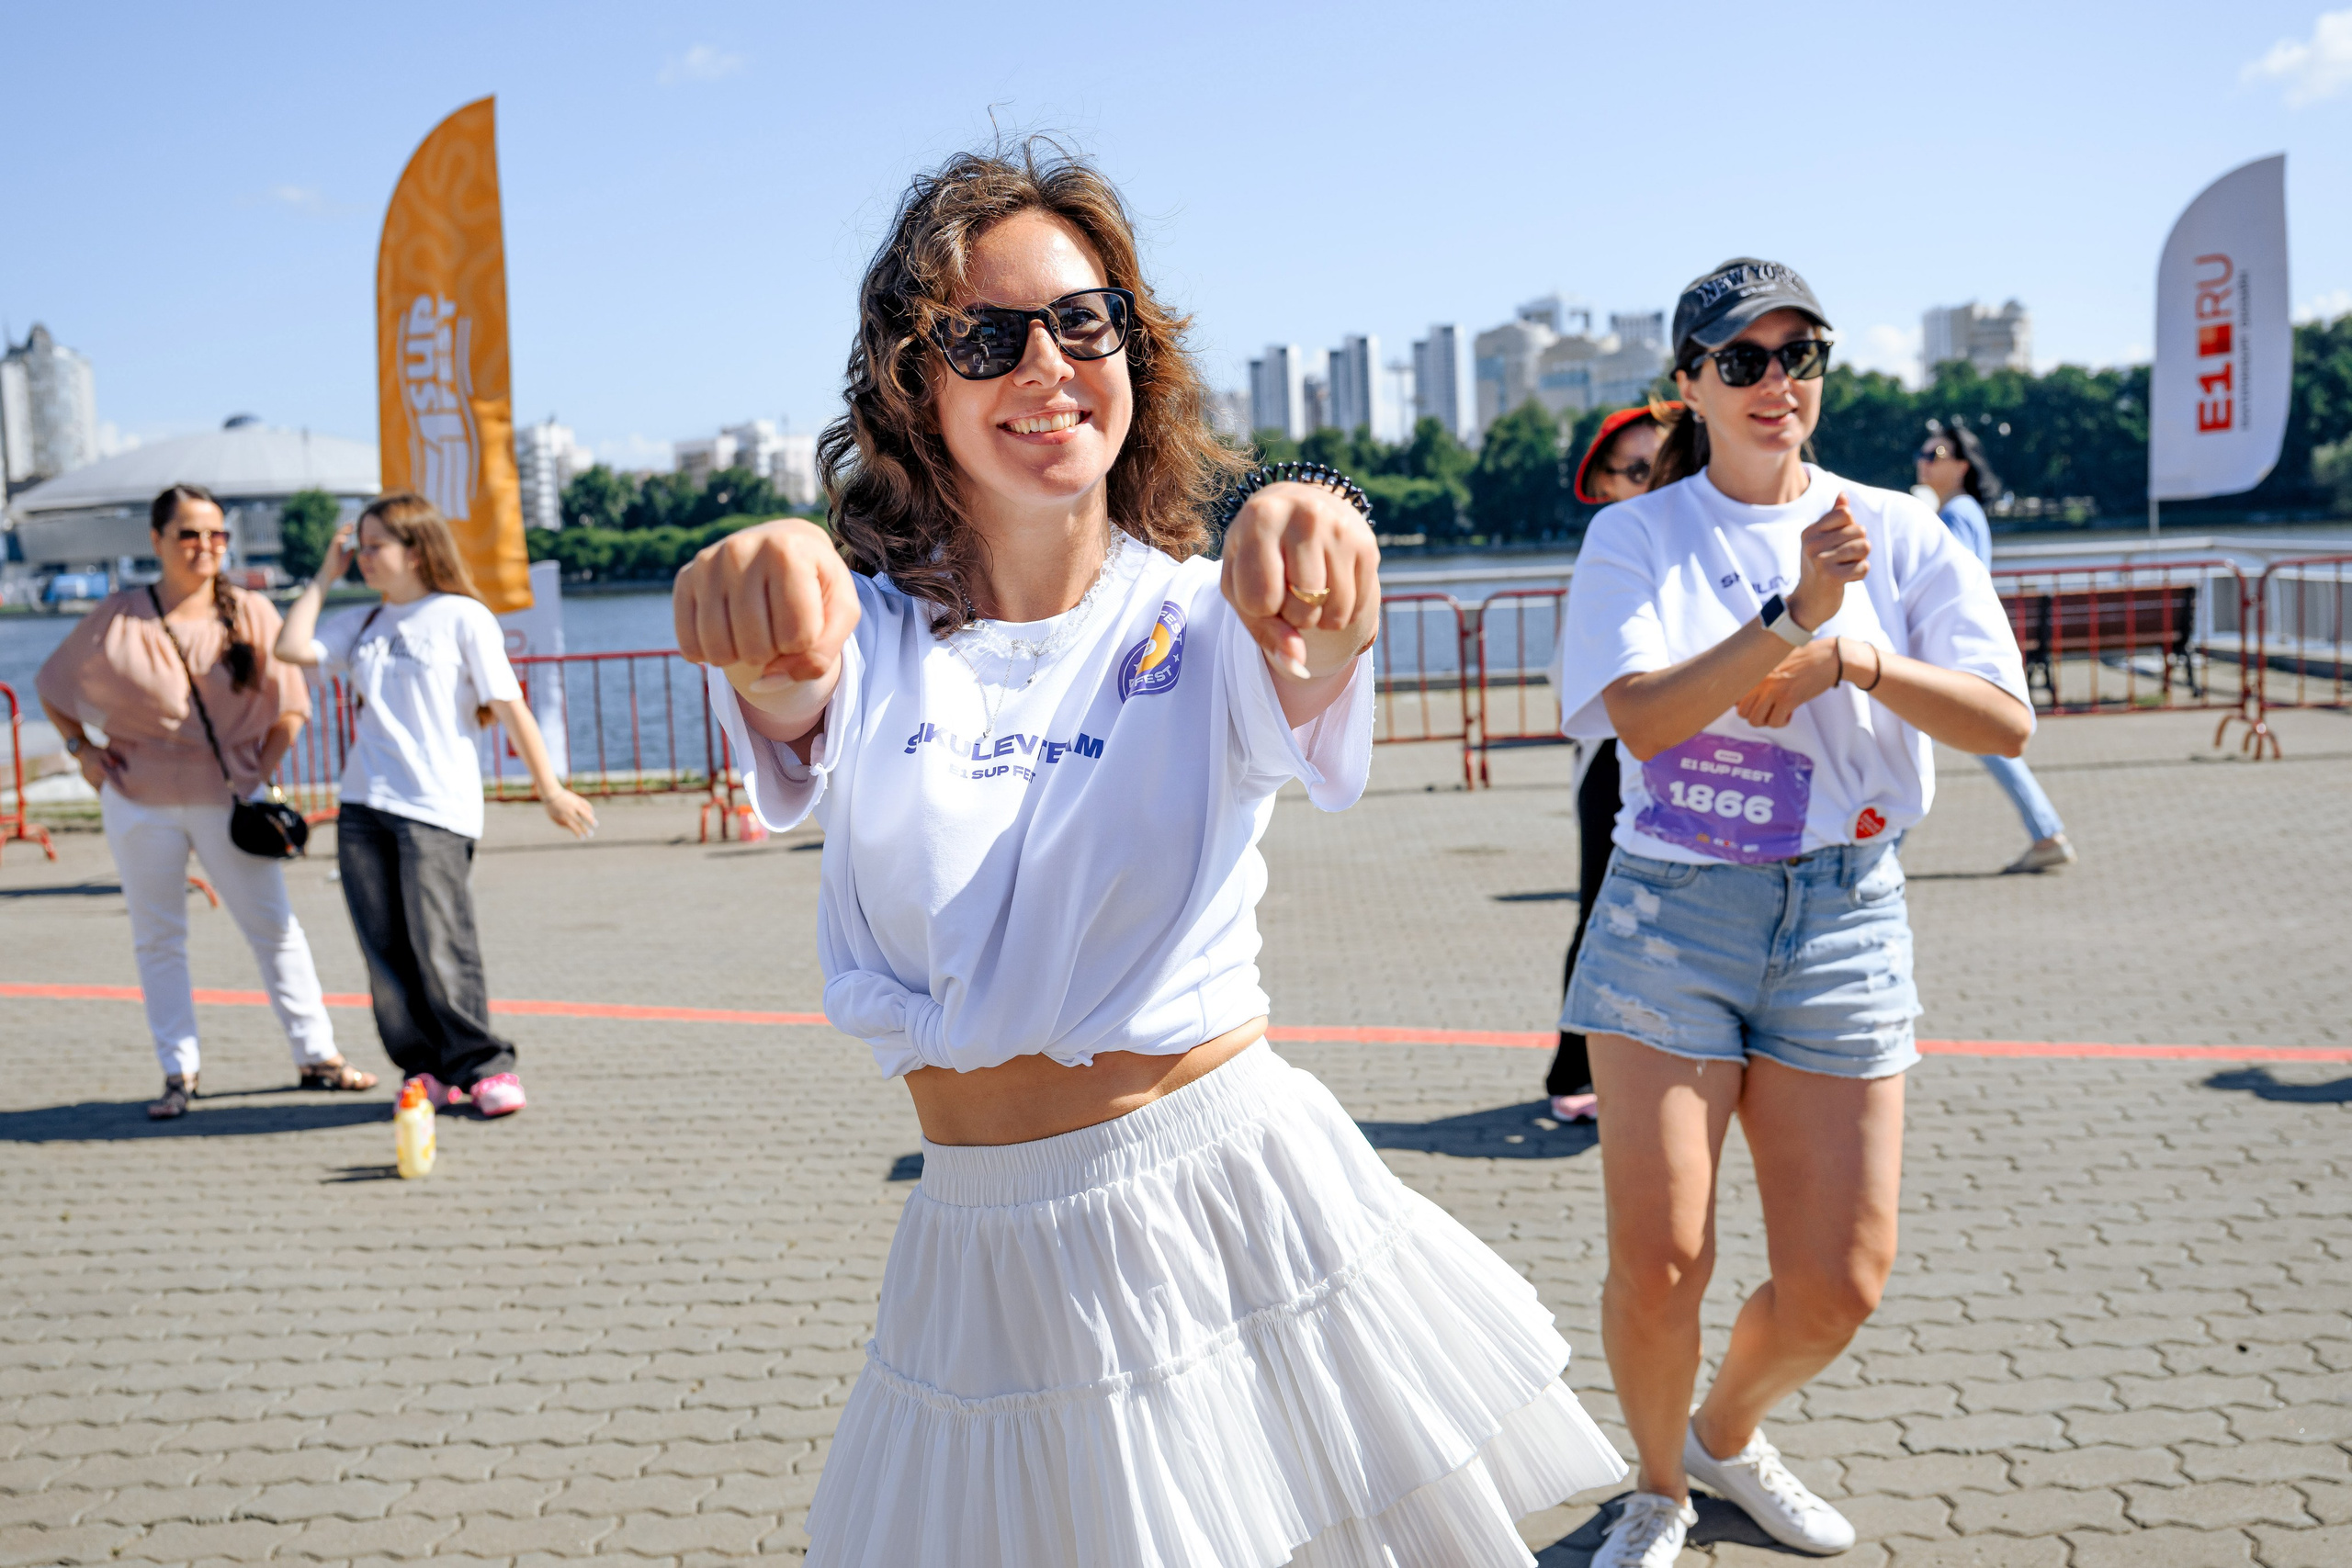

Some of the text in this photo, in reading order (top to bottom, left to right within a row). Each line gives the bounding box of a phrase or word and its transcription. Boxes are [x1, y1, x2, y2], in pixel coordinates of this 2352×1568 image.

[1695, 265, 1749, 308] NEW
[406, 293, 437, 412] SUP
[2193, 253, 2233, 433] E1 RU
[971, 764, 1010, 780] SUP
[1699, 761, 1731, 775] SUP
[1731, 766, 1775, 784] FEST
[1668, 780, 1776, 825] 1866
